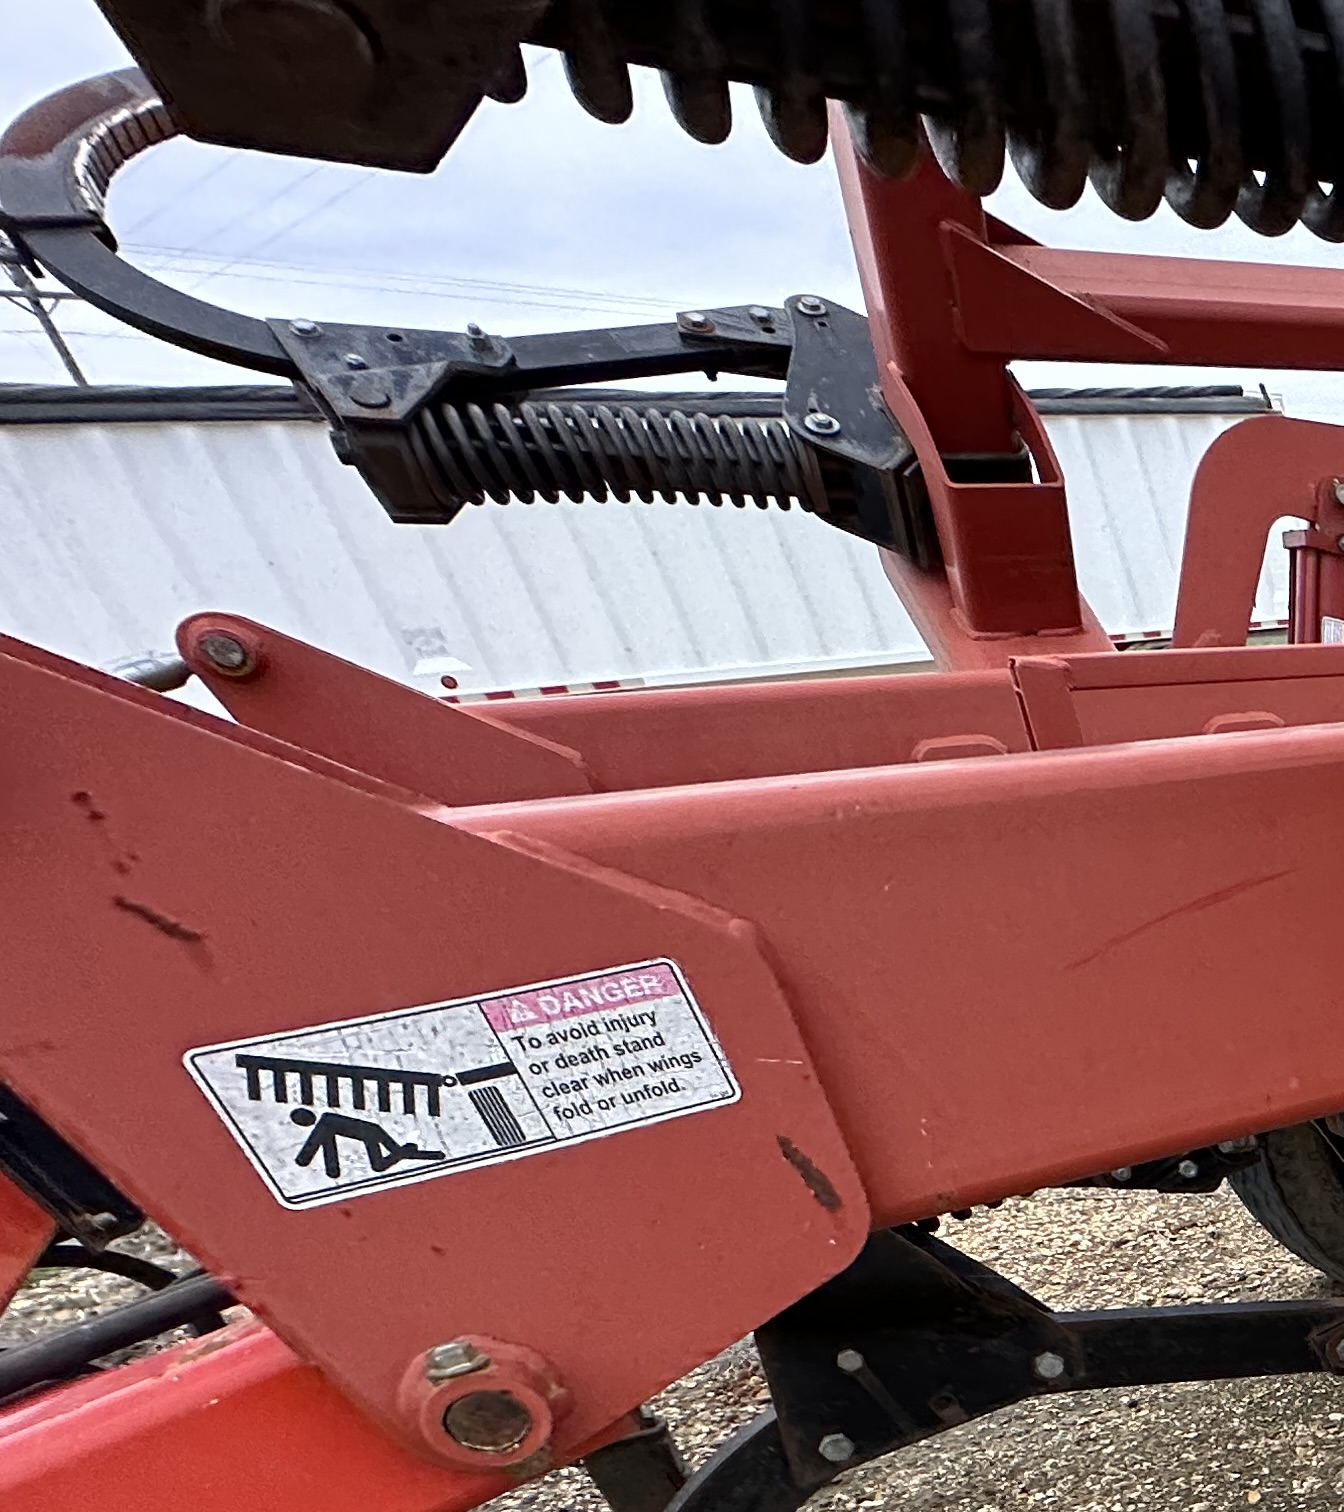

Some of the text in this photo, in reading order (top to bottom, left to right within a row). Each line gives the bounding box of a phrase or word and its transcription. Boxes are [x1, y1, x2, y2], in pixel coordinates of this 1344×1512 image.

[538, 974, 664, 1015] DANGER
[511, 1010, 658, 1051] To avoid injury
[528, 1032, 666, 1076] or death stand
[542, 1050, 703, 1099] clear when wings
[553, 1077, 687, 1122] fold or unfold.
